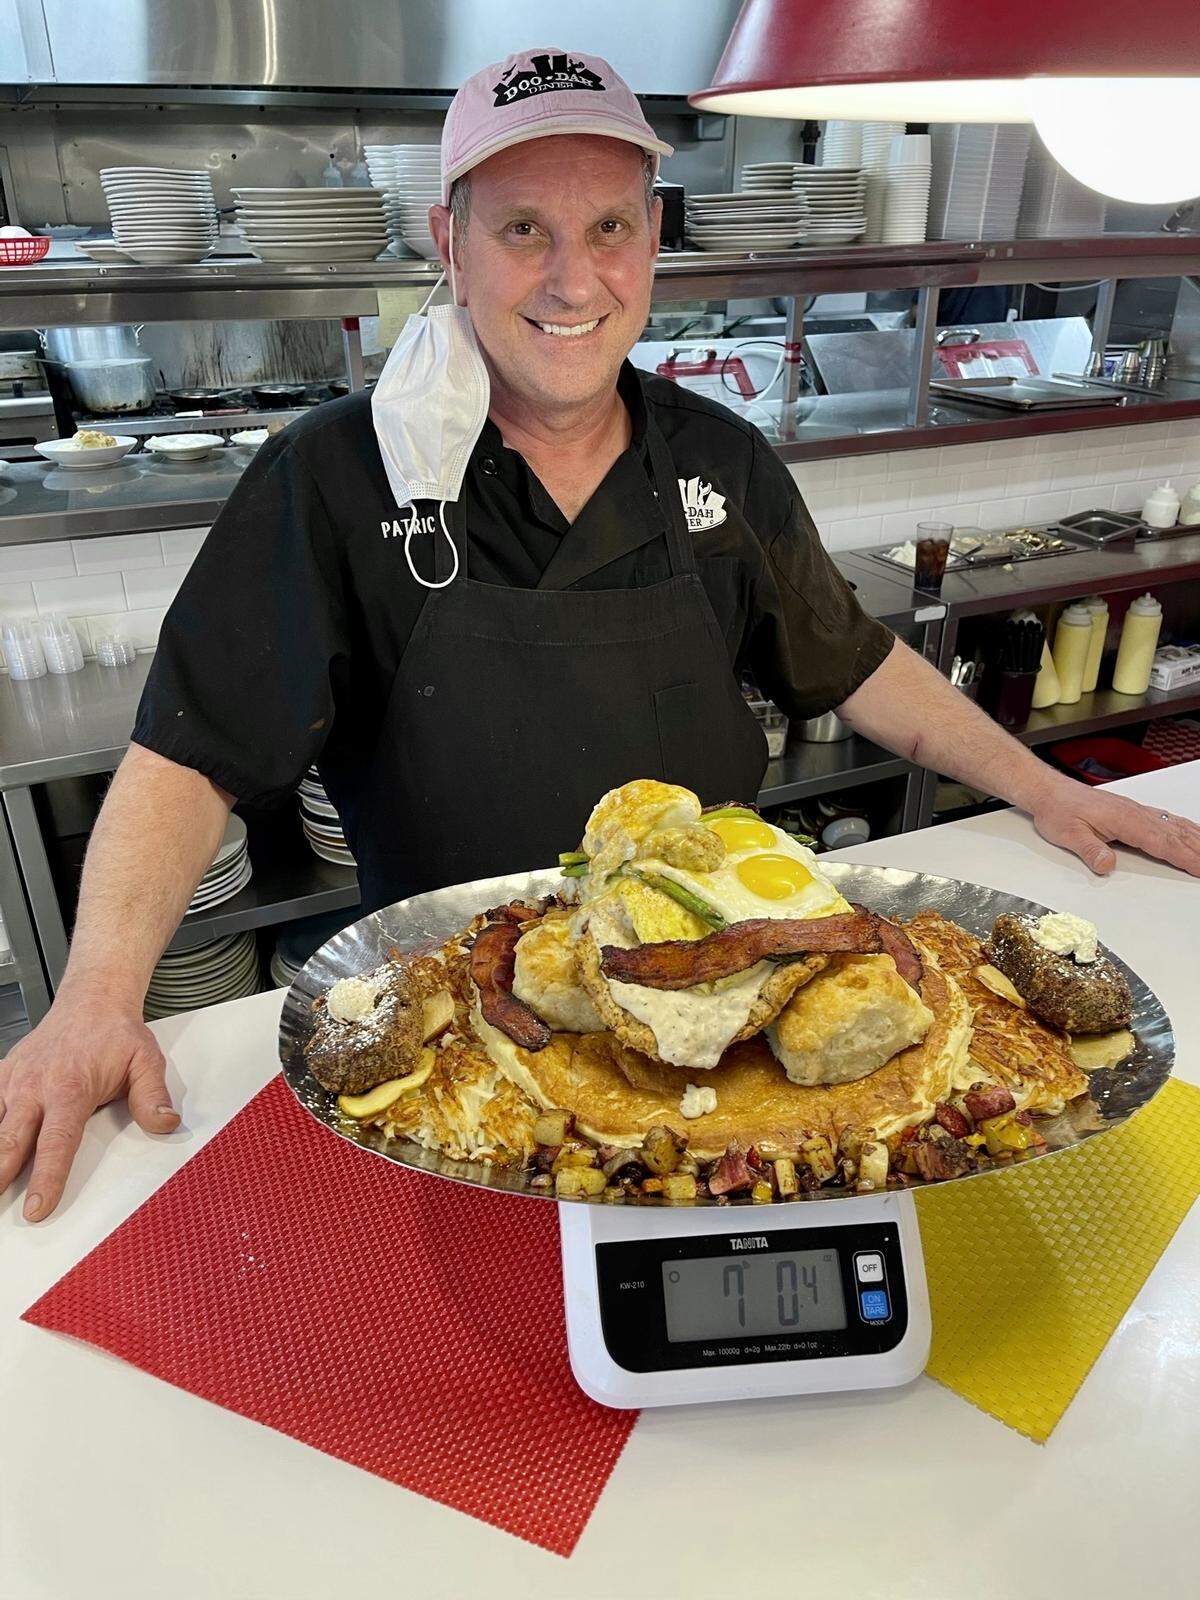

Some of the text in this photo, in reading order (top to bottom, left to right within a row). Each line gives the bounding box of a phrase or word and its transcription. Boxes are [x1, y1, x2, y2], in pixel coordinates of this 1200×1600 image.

[528, 81, 575, 94] DINER
[729, 1236, 769, 1251] TANITA
[862, 1263, 878, 1273] OFF
[619, 1280, 646, 1290] KW-210
[867, 1294, 881, 1304] ON
[865, 1306, 886, 1316] TARE
